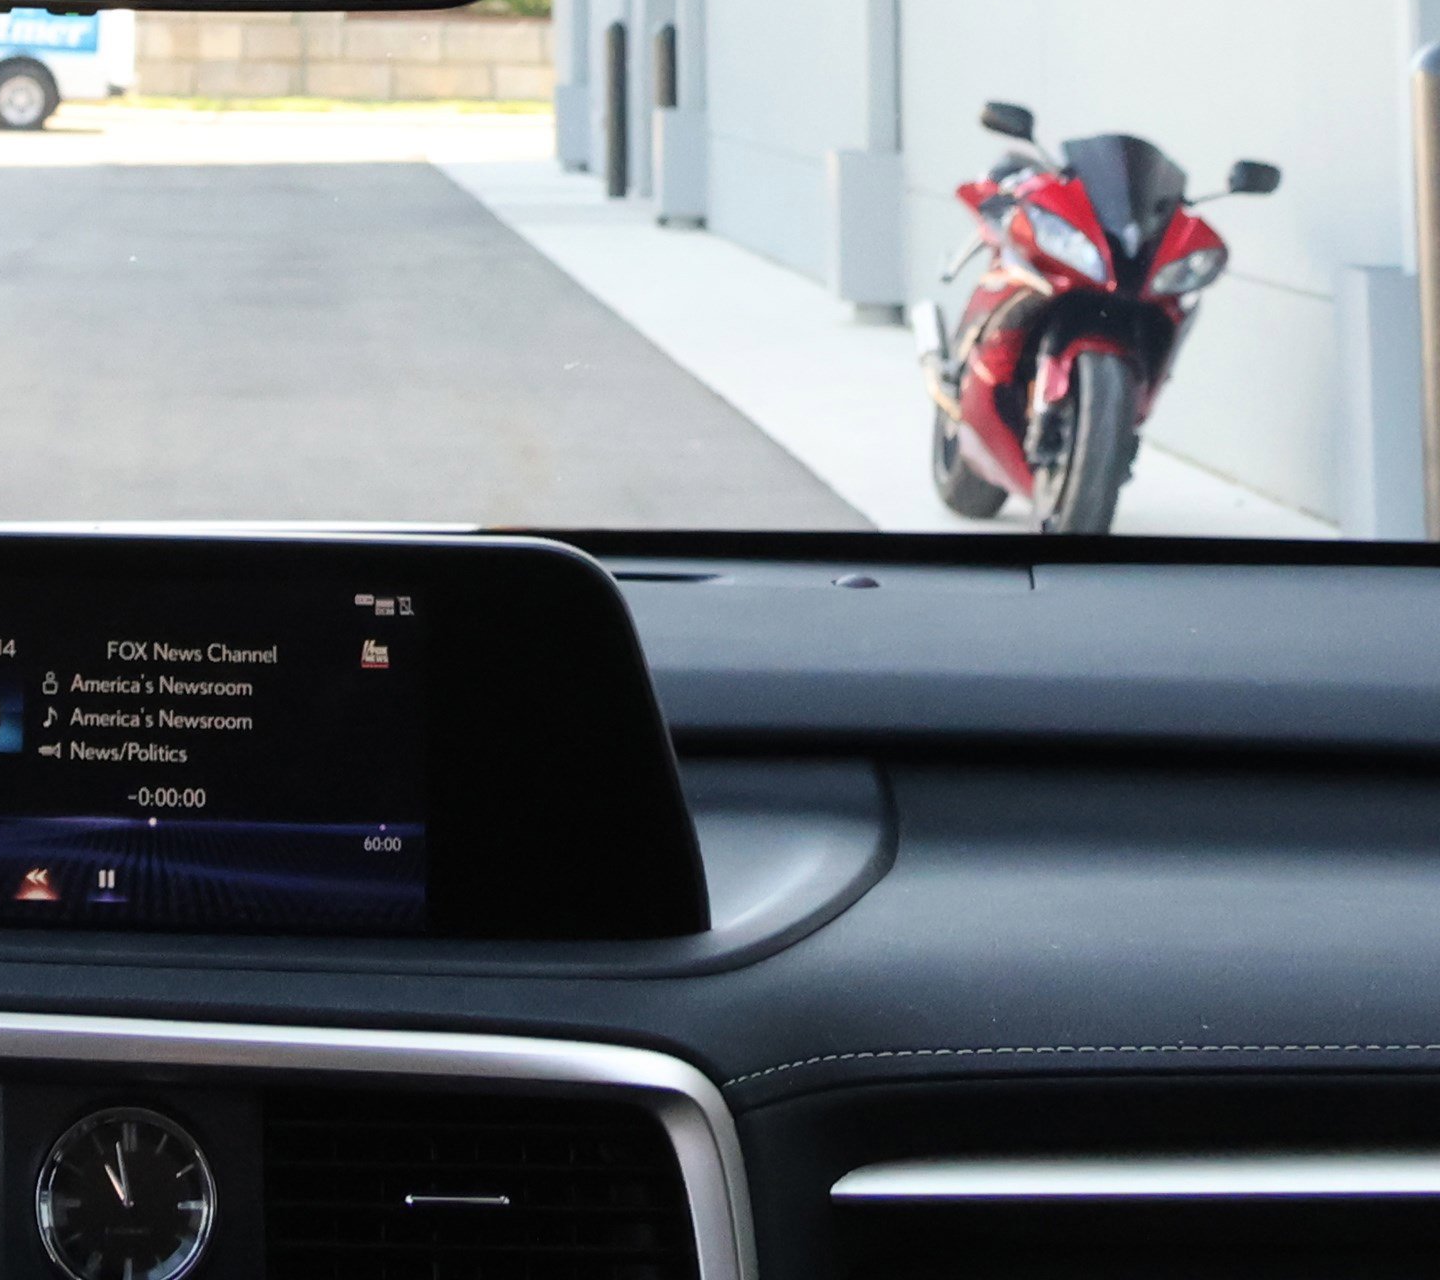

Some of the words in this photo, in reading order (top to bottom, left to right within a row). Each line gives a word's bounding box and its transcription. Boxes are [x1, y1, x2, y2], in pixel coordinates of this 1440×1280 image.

[106, 641, 148, 661] FOX
[153, 643, 202, 662] News
[207, 643, 278, 663] Channel
[70, 663, 154, 694] America's
[159, 675, 253, 696] Newsroom
[70, 697, 154, 728] America's
[159, 709, 253, 730] Newsroom
[70, 741, 188, 763] News/Politics
[128, 786, 207, 808] -0:00:00
[363, 836, 402, 852] 60:00
